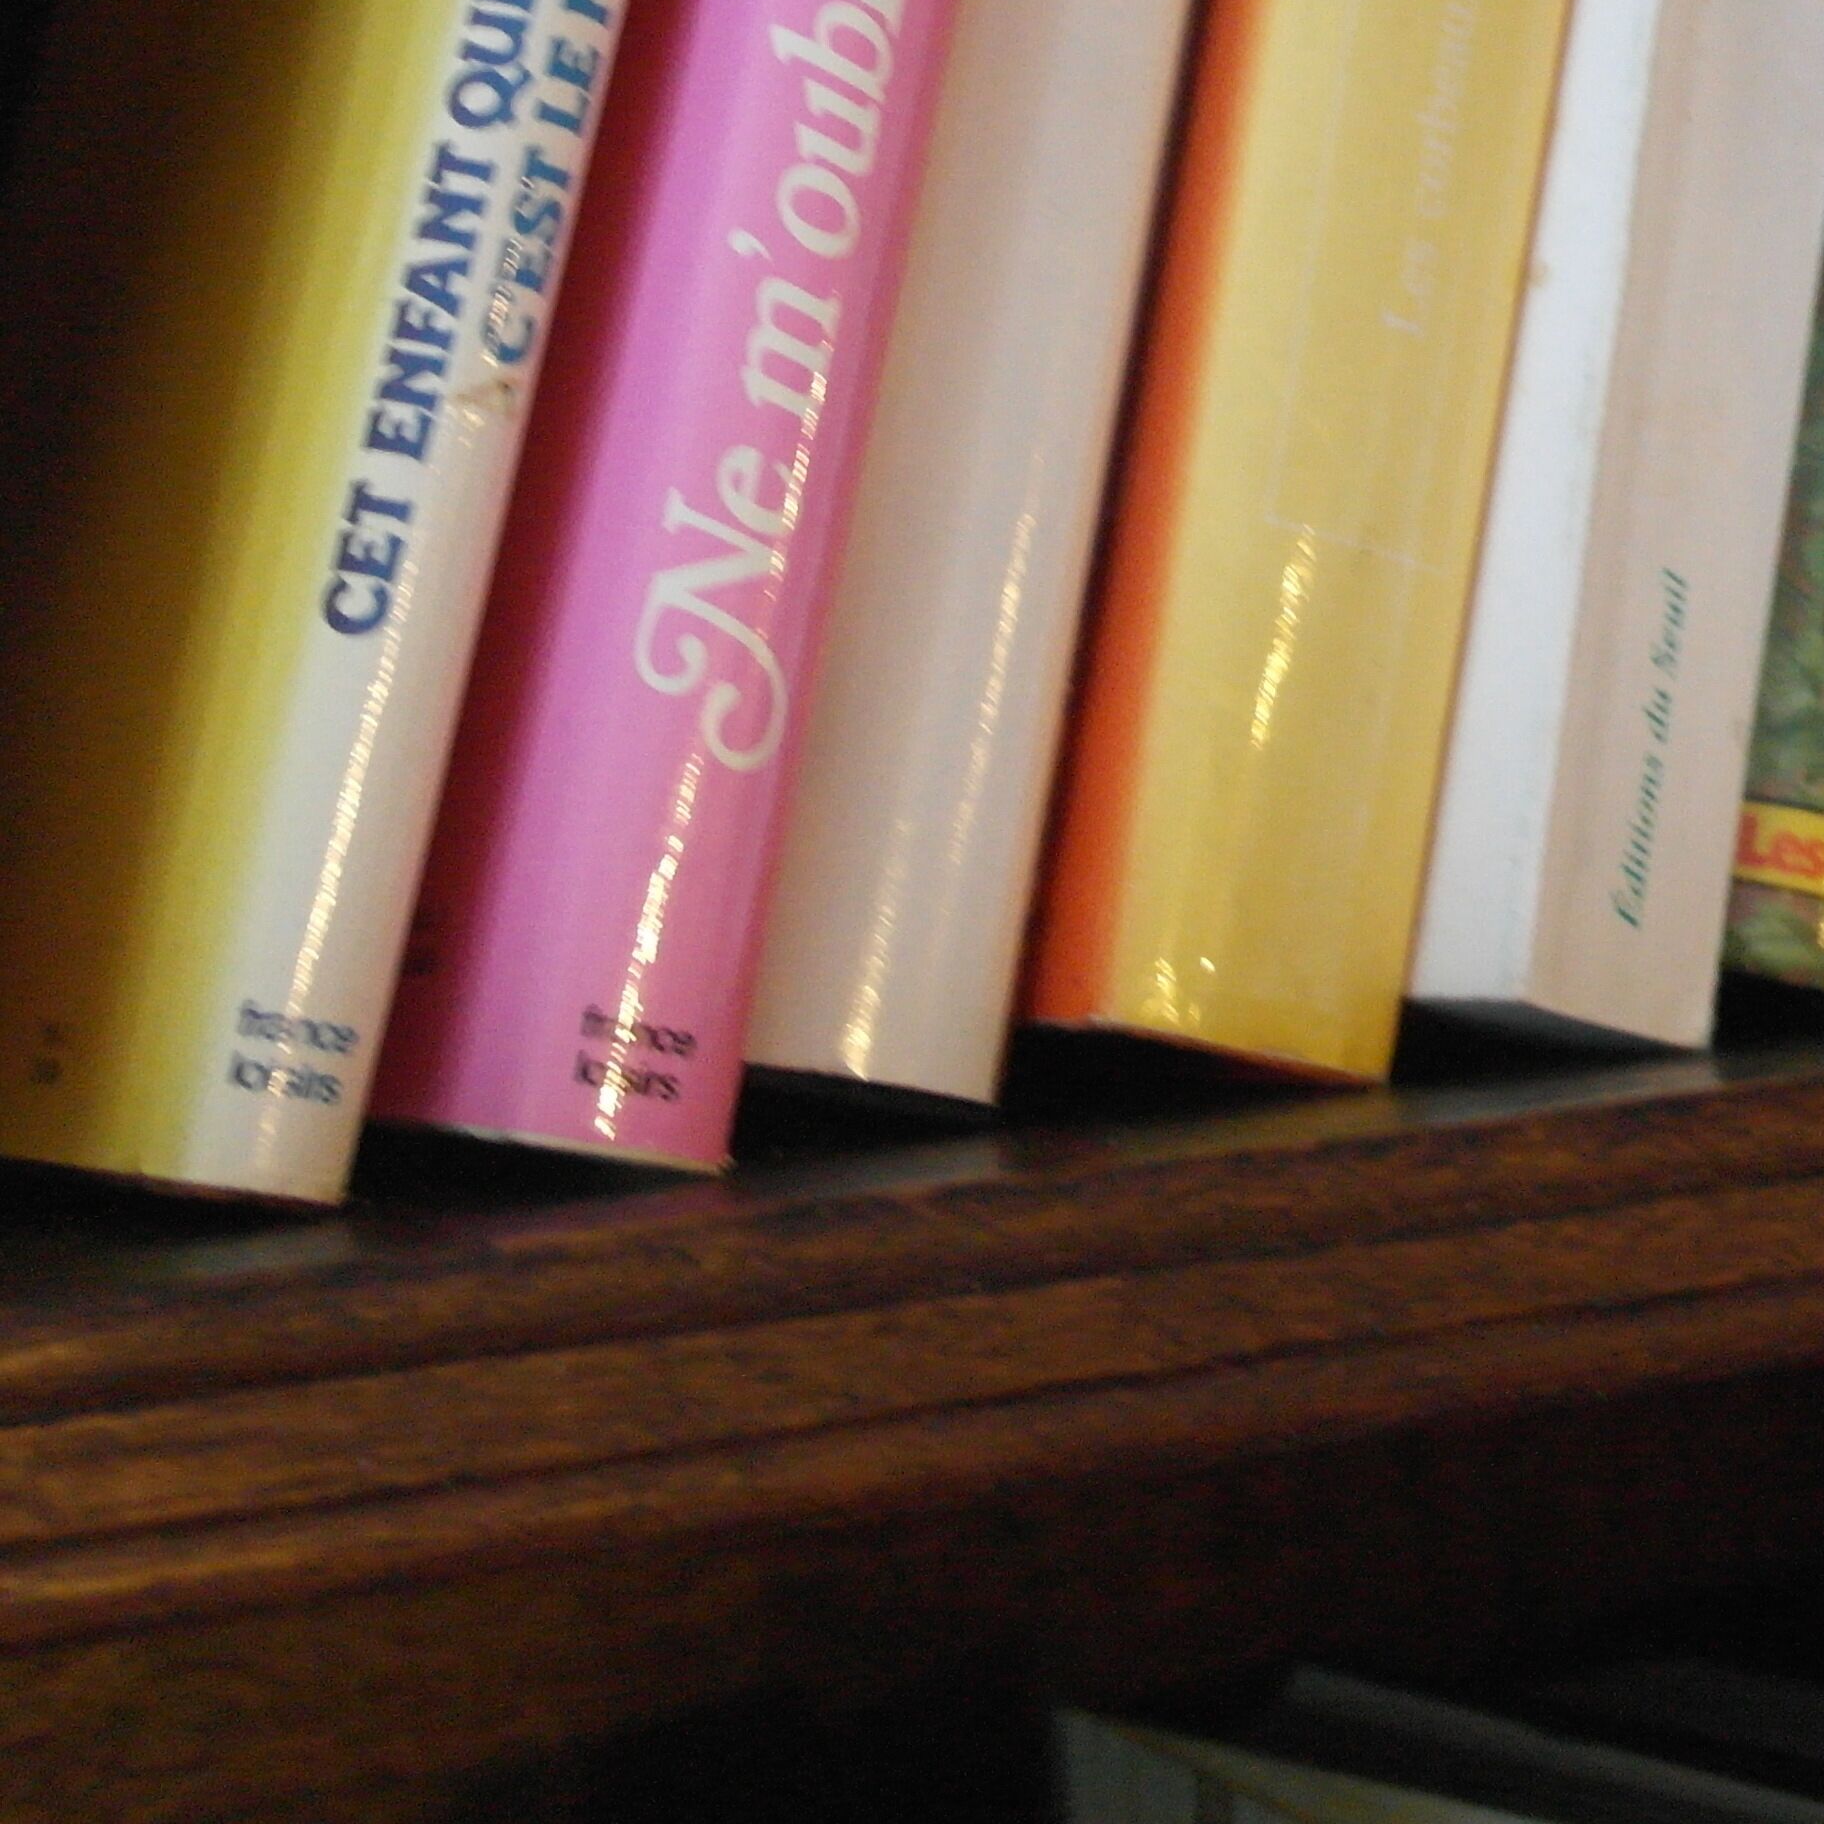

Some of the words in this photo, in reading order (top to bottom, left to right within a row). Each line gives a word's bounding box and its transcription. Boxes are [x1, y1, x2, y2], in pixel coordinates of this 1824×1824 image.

[532, 38, 601, 135] LE
[362, 141, 495, 461] ENFANT
[321, 478, 413, 635] CET
[635, 444, 808, 771] Ne
[1641, 686, 1673, 744] du
